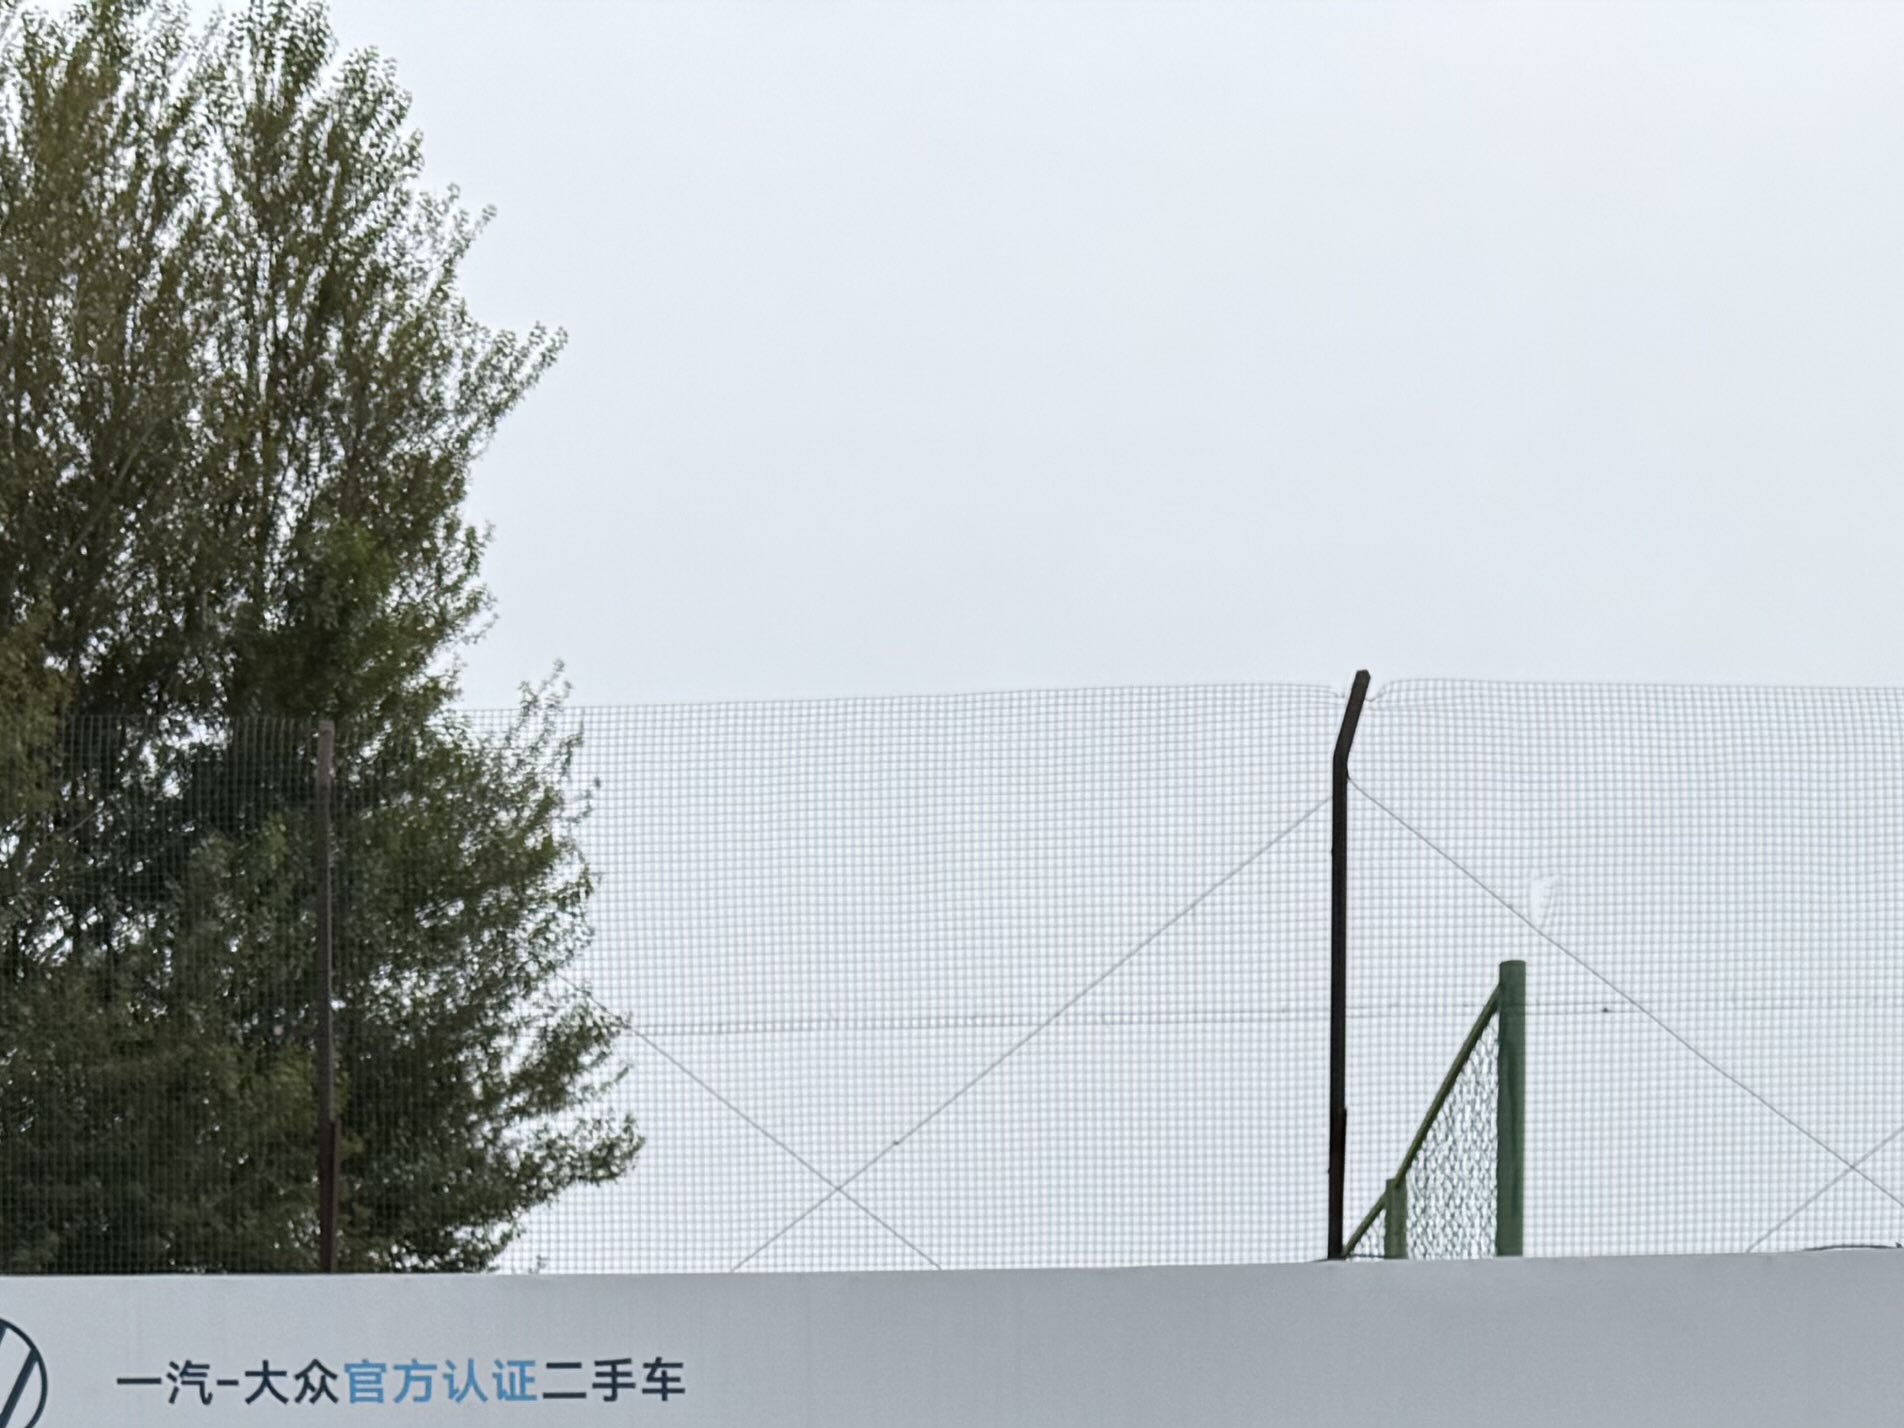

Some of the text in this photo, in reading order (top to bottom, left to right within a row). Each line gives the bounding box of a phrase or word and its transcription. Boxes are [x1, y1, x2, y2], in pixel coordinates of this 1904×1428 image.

[116, 1356, 686, 1406] 一汽-大众官方认证二手车
